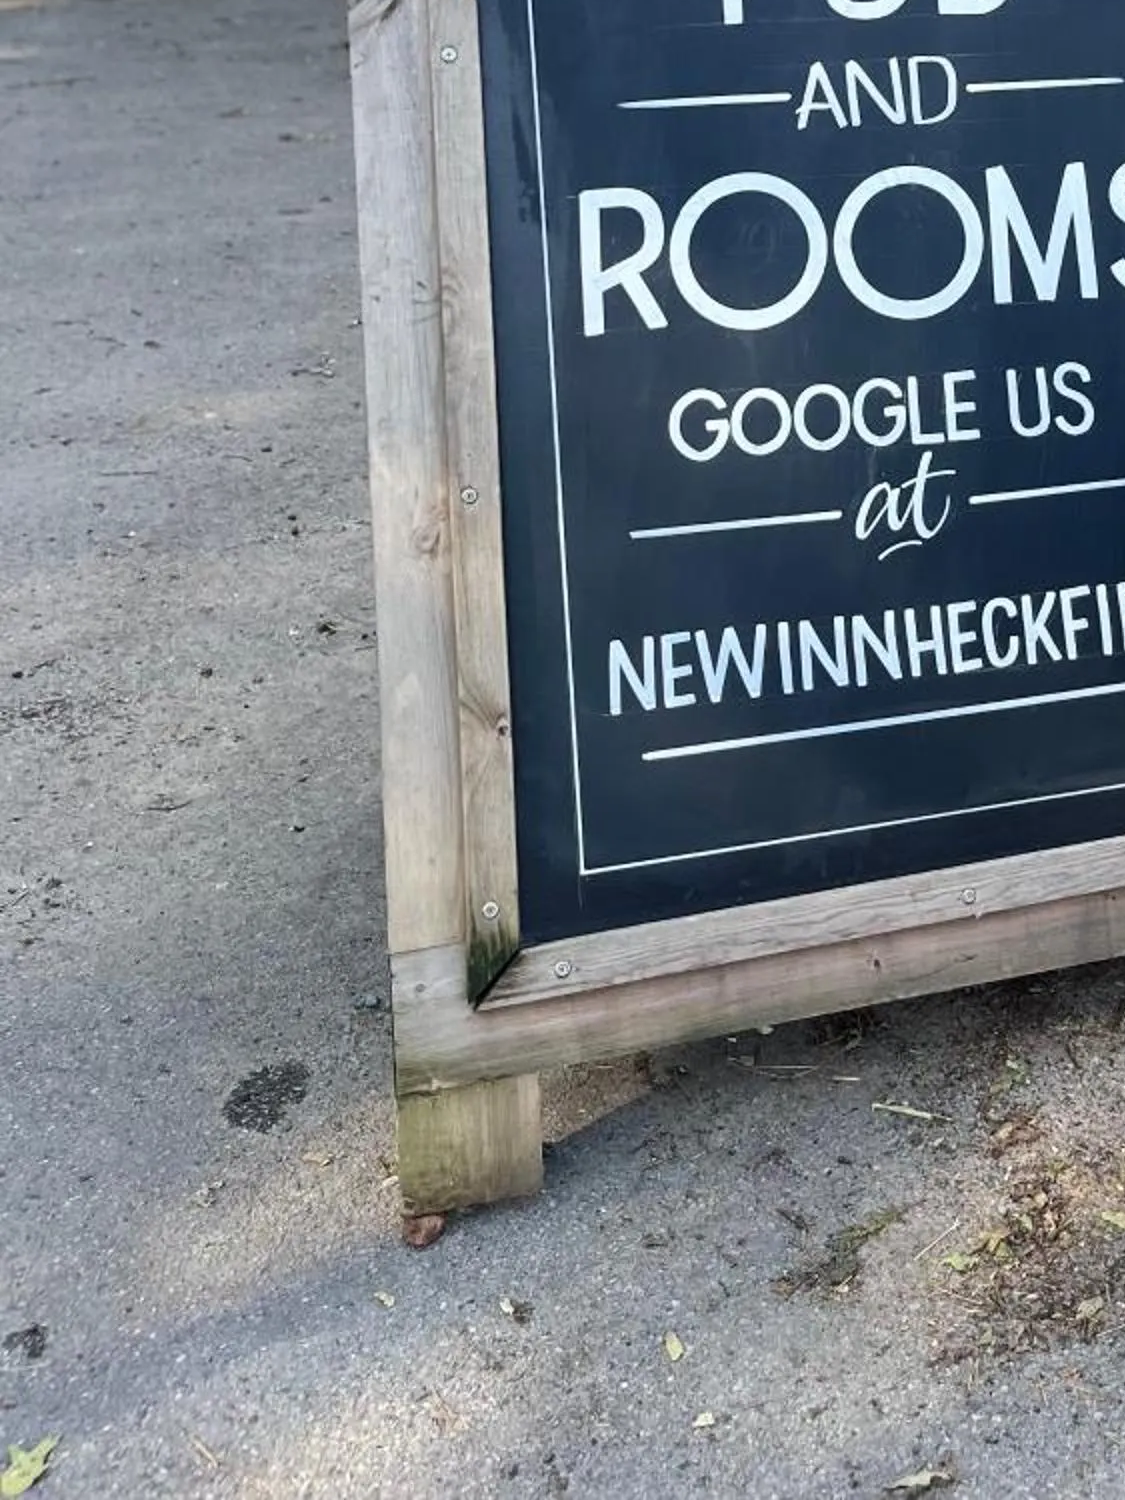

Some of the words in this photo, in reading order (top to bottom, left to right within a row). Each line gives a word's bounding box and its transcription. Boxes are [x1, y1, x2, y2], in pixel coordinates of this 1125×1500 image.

[795, 55, 958, 131] AND
[668, 369, 981, 463] GOOGLE
[1005, 361, 1095, 437] US
[855, 450, 957, 561] at
